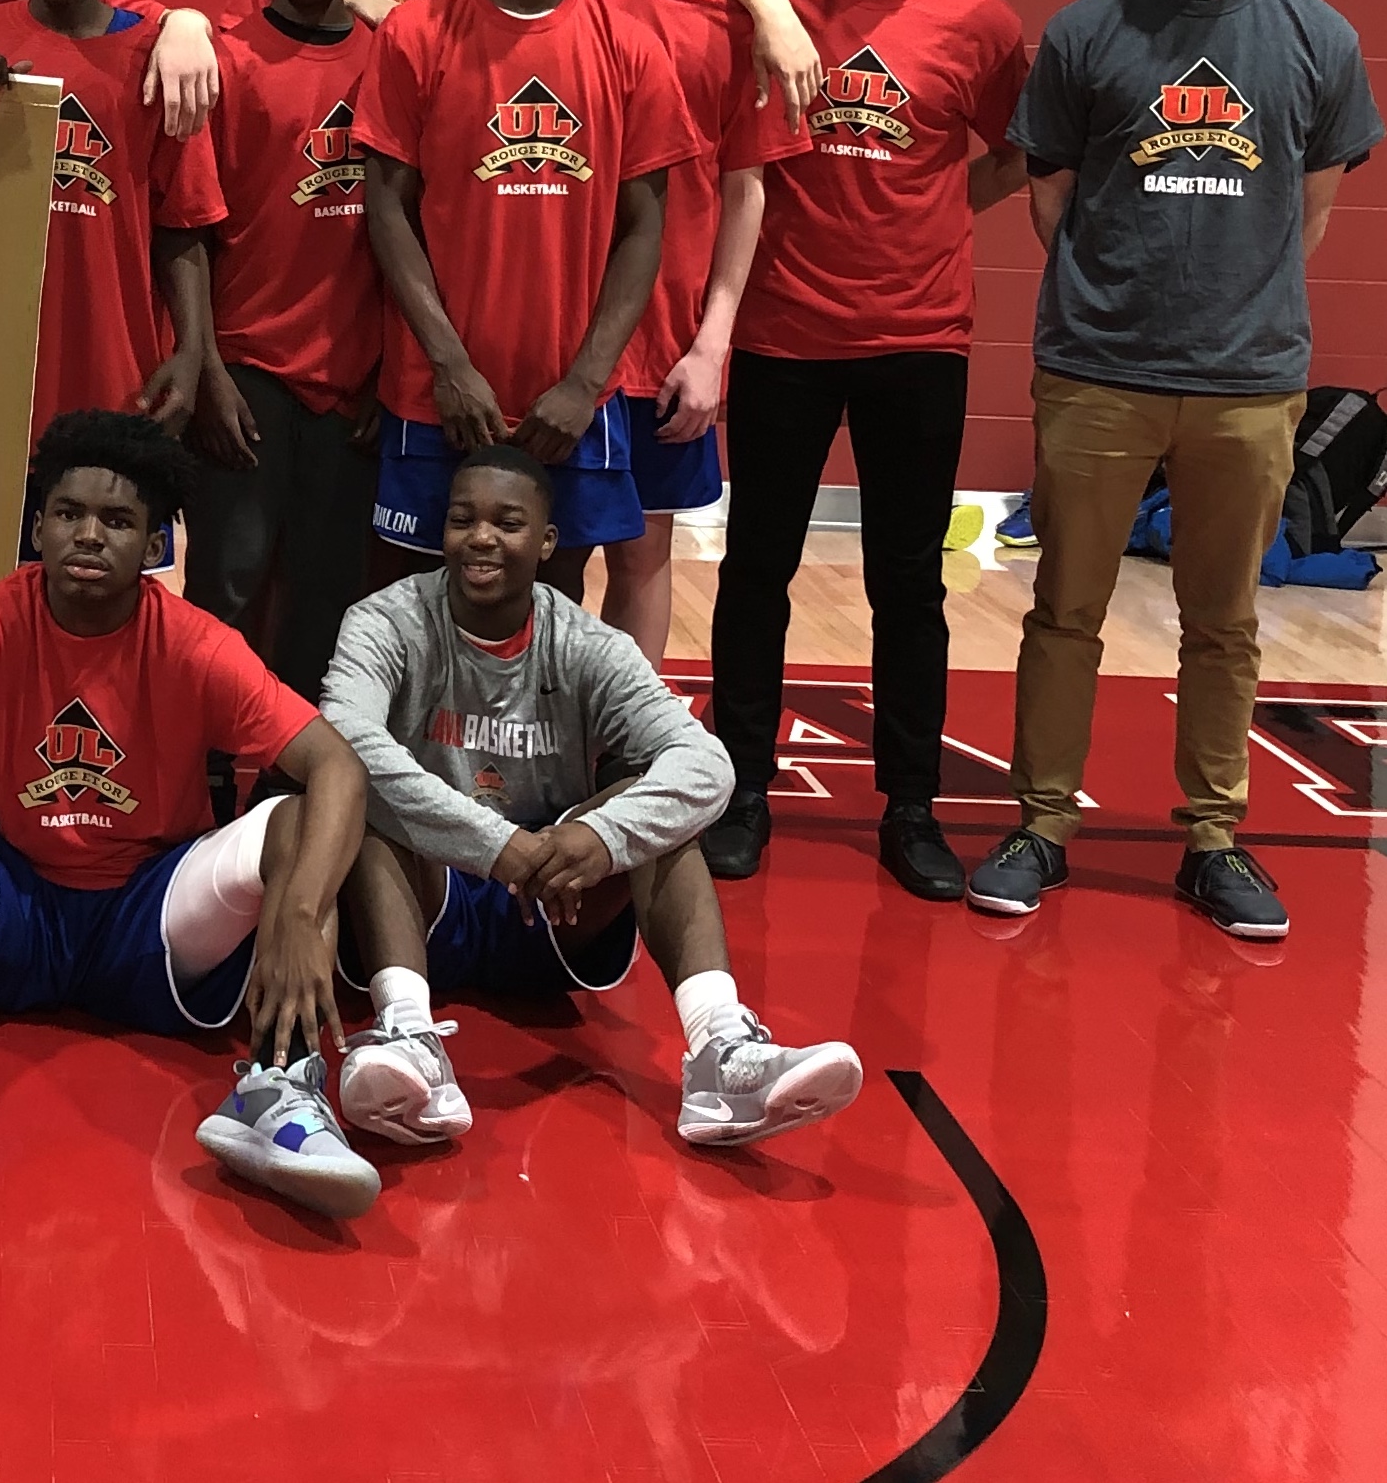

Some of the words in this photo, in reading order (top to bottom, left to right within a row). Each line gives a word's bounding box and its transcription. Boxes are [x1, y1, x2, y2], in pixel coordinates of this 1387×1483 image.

[826, 67, 902, 109] UL
[1160, 84, 1243, 125] UL
[496, 103, 574, 139] UL
[814, 110, 862, 125] ROUGE
[865, 112, 884, 124] ET
[883, 118, 904, 136] OR
[820, 143, 893, 161] BASKETBALL
[1147, 131, 1204, 151] ROUGE
[1227, 137, 1251, 154] OR
[488, 145, 538, 165] ROUGE
[541, 145, 558, 157] ET
[559, 150, 579, 166] OR
[71, 163, 89, 175] ET
[88, 170, 106, 188] OR
[303, 167, 350, 190] ROUGE
[1143, 174, 1245, 197] BASKETBALL
[497, 183, 569, 195] BASKETBALL
[45, 723, 116, 768] UL
[81, 772, 101, 785] ET
[100, 780, 123, 799] OR
[40, 812, 113, 829] BASKETBALL
